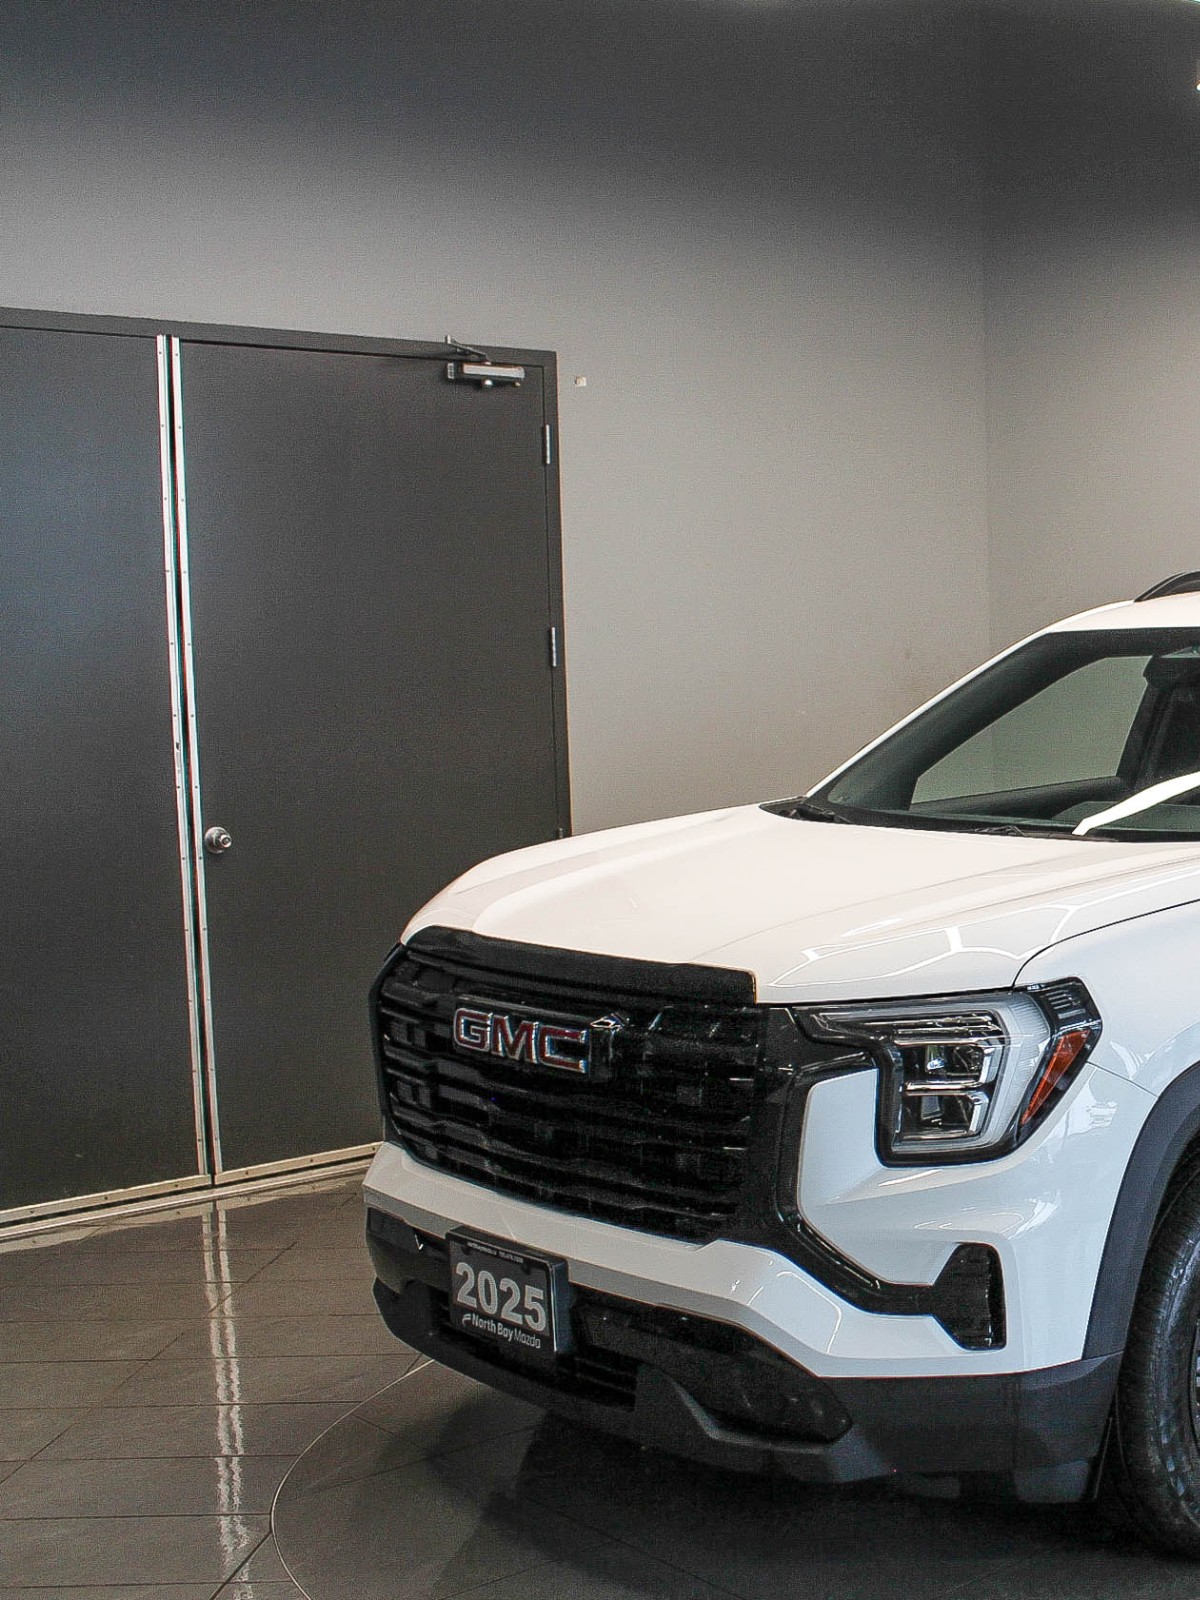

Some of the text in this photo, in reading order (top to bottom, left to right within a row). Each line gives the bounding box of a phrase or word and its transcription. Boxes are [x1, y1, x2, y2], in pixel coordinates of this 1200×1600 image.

[454, 1008, 587, 1073] GMC
[456, 1262, 546, 1331] 2025
[472, 1313, 541, 1349] North Bay Mazda
